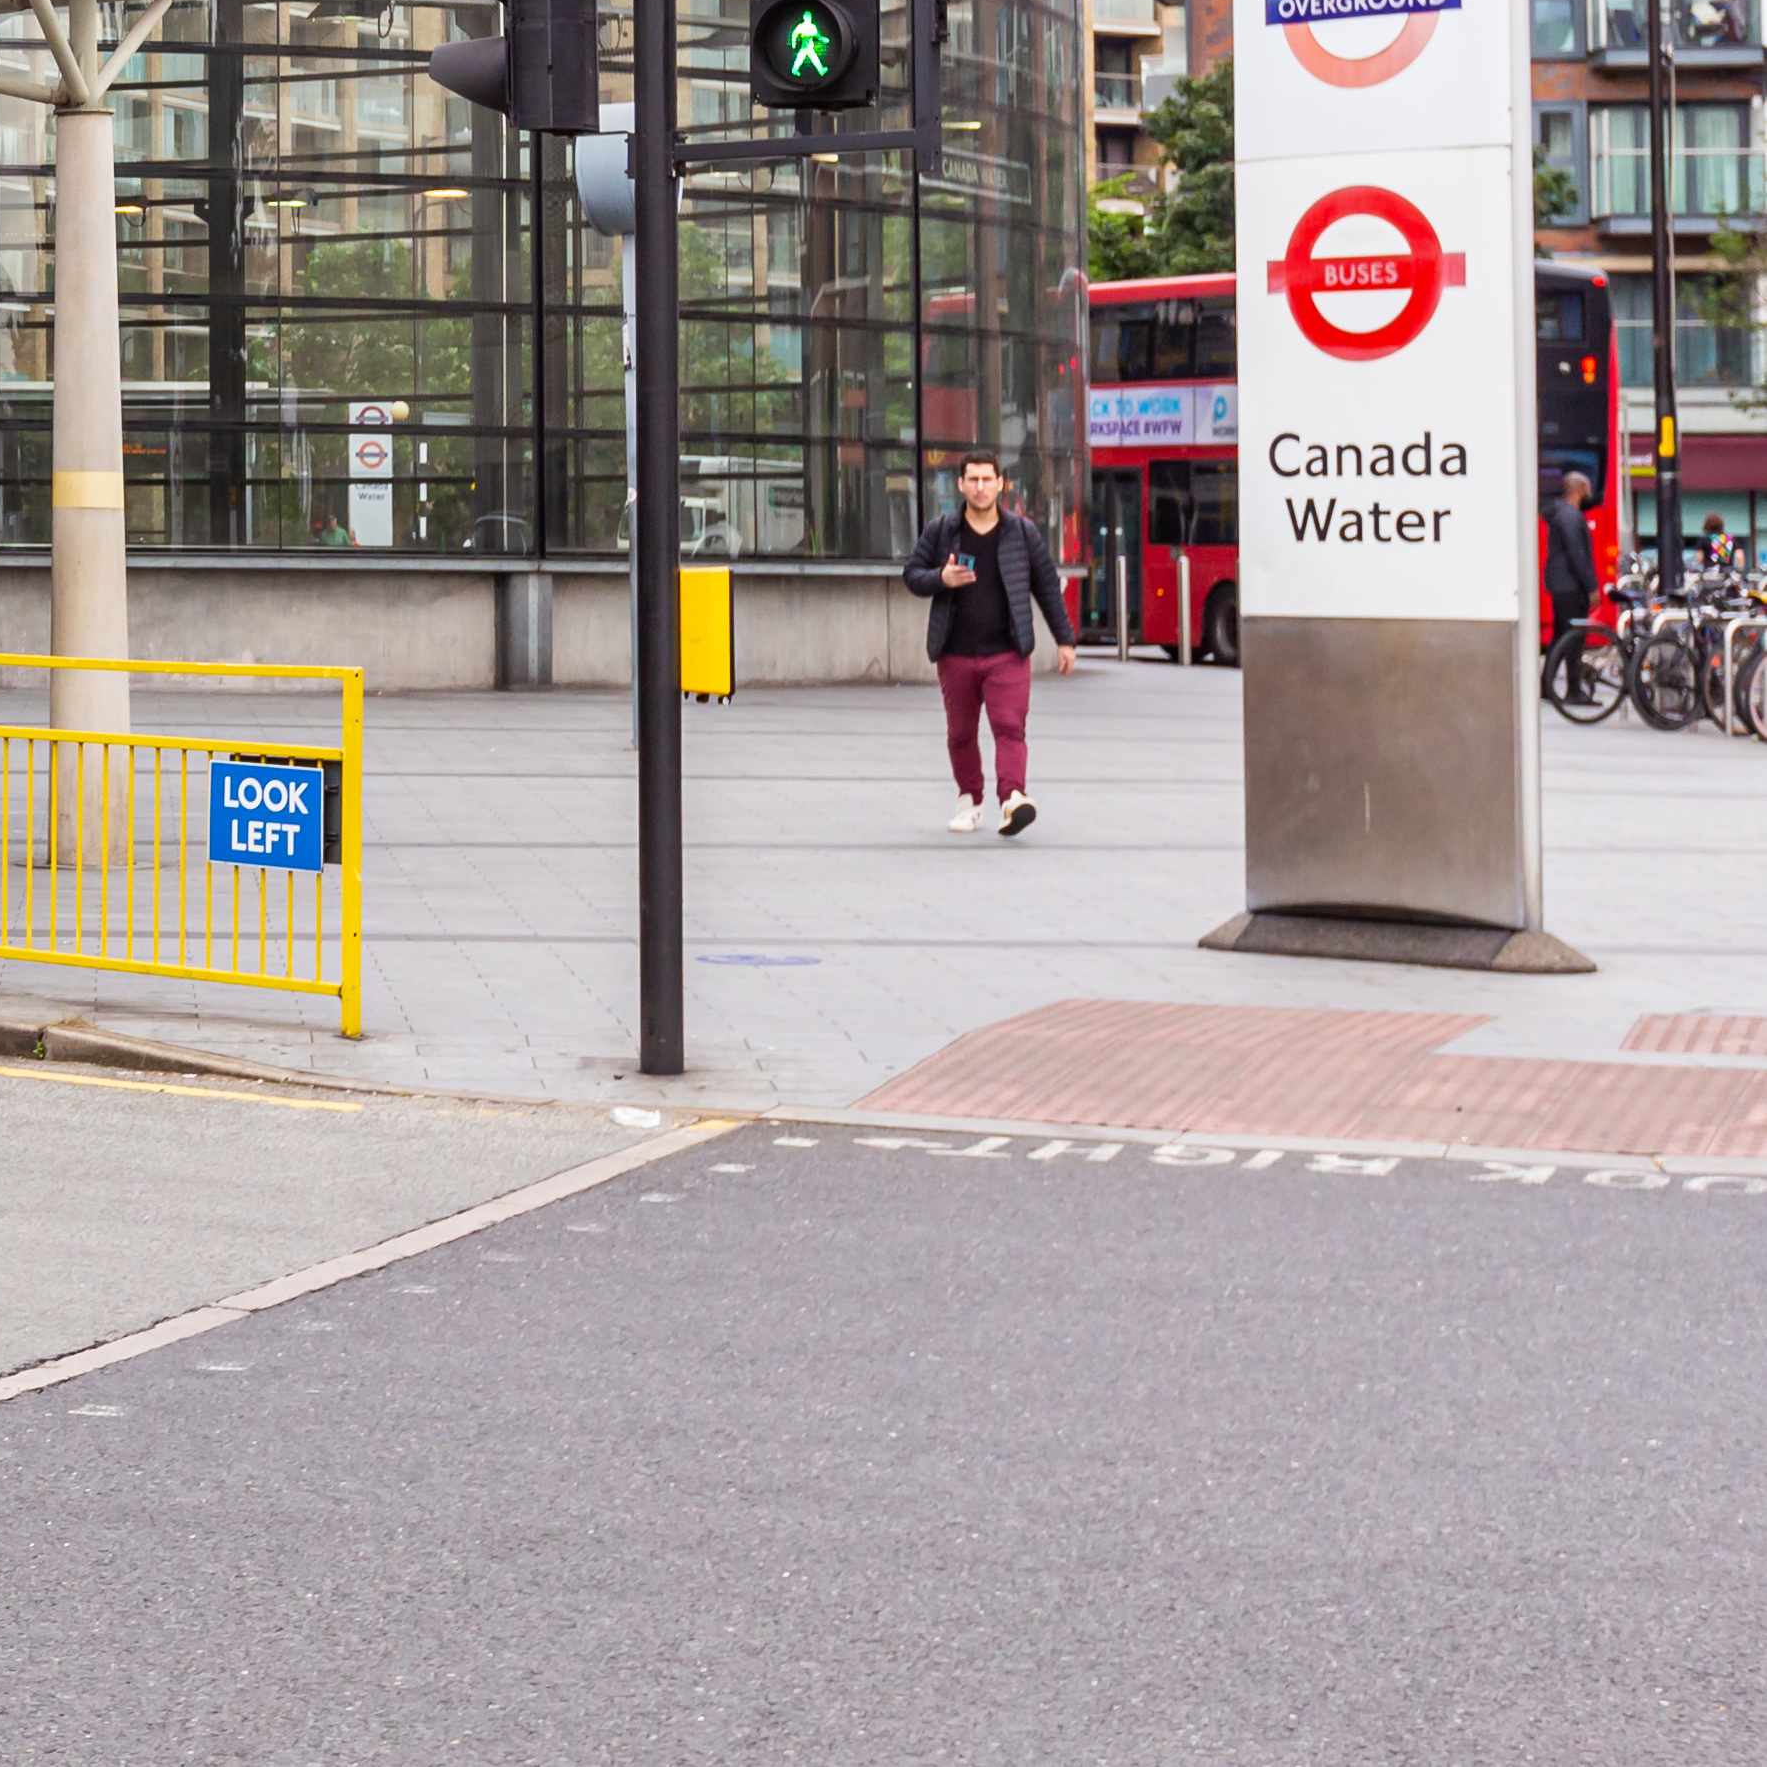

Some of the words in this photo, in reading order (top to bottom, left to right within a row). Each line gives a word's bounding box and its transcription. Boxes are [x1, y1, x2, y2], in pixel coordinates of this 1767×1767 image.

[1324, 263, 1399, 286] BUSES
[1139, 396, 1181, 416] WORK
[1268, 432, 1468, 478] Canada
[358, 492, 386, 501] Water
[1285, 497, 1452, 543] Water
[223, 776, 310, 816] LOOK
[229, 819, 302, 858] LEFT
[925, 1135, 1402, 1177] RIGHT
